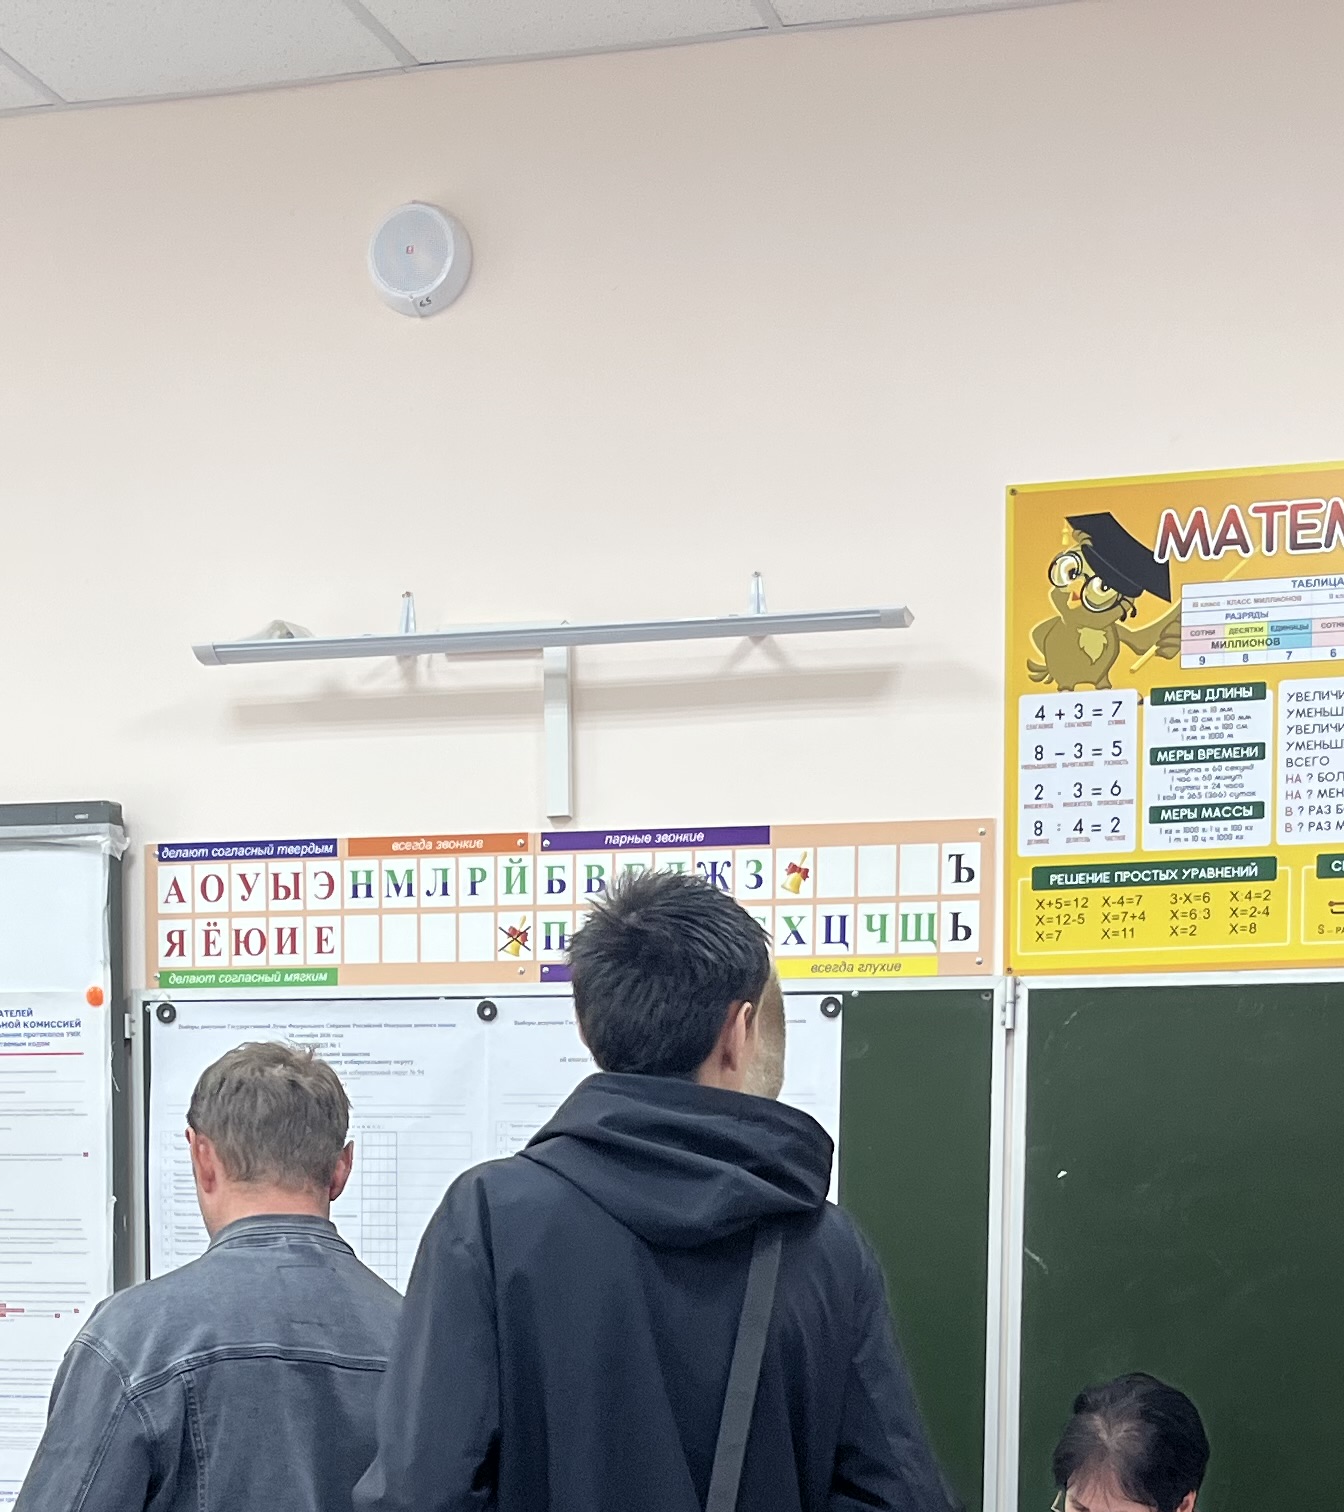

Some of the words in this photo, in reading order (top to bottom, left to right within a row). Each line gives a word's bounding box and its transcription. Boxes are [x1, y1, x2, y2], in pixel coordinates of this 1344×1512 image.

[1291, 577, 1344, 589] ТАБЛИЦА
[1211, 638, 1280, 649] МИЛЛИОНОВ
[1164, 690, 1201, 702] МЕРЫ
[1206, 687, 1253, 701] ДЛИНЫ
[1157, 750, 1194, 762] МЕРЫ
[1198, 747, 1259, 759] ВРЕМЕНИ
[1286, 756, 1330, 768] ВСЕГО
[1286, 774, 1301, 784] НА
[1307, 773, 1313, 783] ?
[1285, 790, 1301, 800] НА
[1307, 789, 1313, 799] ?
[1161, 809, 1198, 820] МЕРЫ
[1201, 806, 1253, 818] МАССЫ
[1285, 806, 1292, 816] В
[1298, 806, 1304, 815] ?
[1308, 804, 1331, 815] РАЗ
[1285, 823, 1292, 833] В
[1298, 822, 1303, 831] ?
[1308, 821, 1331, 831] РАЗ
[605, 833, 652, 846] парные
[655, 831, 704, 844] звонкие
[162, 847, 208, 859] делают
[212, 845, 274, 856] согласный
[277, 843, 332, 856] твердым
[392, 841, 433, 851] всегда
[436, 839, 483, 849] звонкие
[164, 876, 186, 903] А
[200, 874, 224, 902] О
[236, 874, 261, 901] У
[270, 873, 300, 900] Ы
[314, 871, 335, 899] Э
[350, 870, 373, 898] Н
[386, 869, 415, 898] М
[426, 868, 450, 897] Л
[468, 867, 486, 896] Р
[504, 858, 528, 894] Й
[545, 865, 567, 894] Б
[585, 864, 605, 893] В
[697, 861, 731, 892] Ж
[746, 859, 764, 890] З
[948, 854, 975, 884] Ъ
[1050, 872, 1110, 885] РЕШЕНИЕ
[1114, 868, 1178, 883] ПРОСТЫХ
[1182, 862, 1257, 879] УРАВНЕНИЙ
[165, 930, 186, 957] Я
[204, 922, 222, 956] Ё
[234, 927, 266, 956] Ю
[274, 927, 298, 955] И
[316, 926, 335, 954] Е
[543, 922, 569, 950] П
[782, 916, 806, 945] Х
[822, 915, 850, 951] Ц
[866, 914, 889, 943] Ч
[901, 913, 937, 947] Щ
[949, 912, 973, 941] Ь
[811, 961, 854, 973] всегда
[858, 961, 901, 973] глухие
[169, 972, 215, 985] делают
[218, 971, 281, 983] согласный
[284, 972, 327, 983] мягким
[24, 1019, 81, 1028] КОМИССИЕЙ
